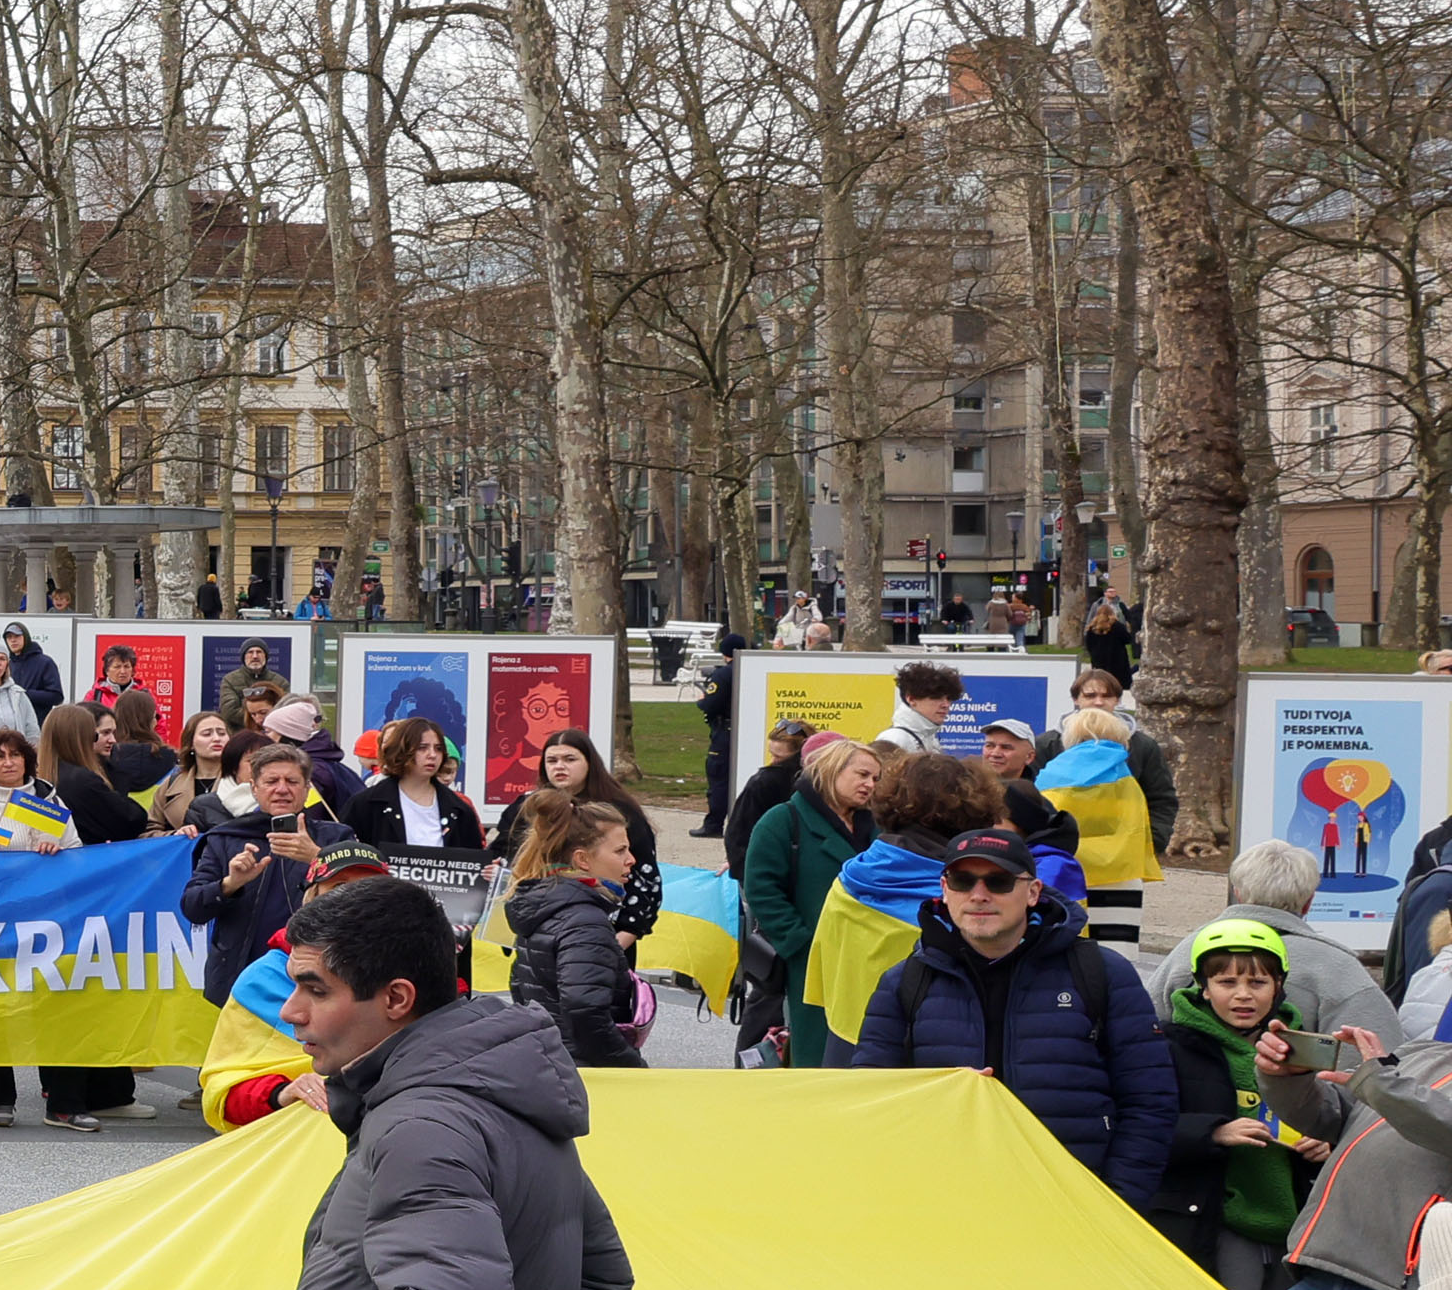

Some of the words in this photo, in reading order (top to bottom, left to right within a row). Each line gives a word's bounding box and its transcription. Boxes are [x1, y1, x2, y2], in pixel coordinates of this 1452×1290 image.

[884, 580, 927, 590] RSPORT
[368, 655, 392, 663] Rojena
[492, 656, 516, 664] Rojena
[775, 690, 807, 698] VSAKA
[775, 701, 863, 710] STROKOVNJAKINJA
[967, 701, 997, 712] NIHČE
[809, 711, 842, 720] NEKOČ
[1283, 710, 1312, 720] TUDI
[1315, 710, 1352, 722] TVOJA
[1283, 725, 1364, 736] PERSPEKTIVA
[1282, 740, 1294, 752] JE
[1296, 740, 1373, 751] POMEMBNA.
[325, 848, 351, 864] HARD
[354, 848, 379, 861] ROCK
[388, 856, 408, 865] THE
[409, 858, 447, 868] WORLD
[447, 860, 482, 871] NEEDS
[387, 865, 480, 886] SECURITY
